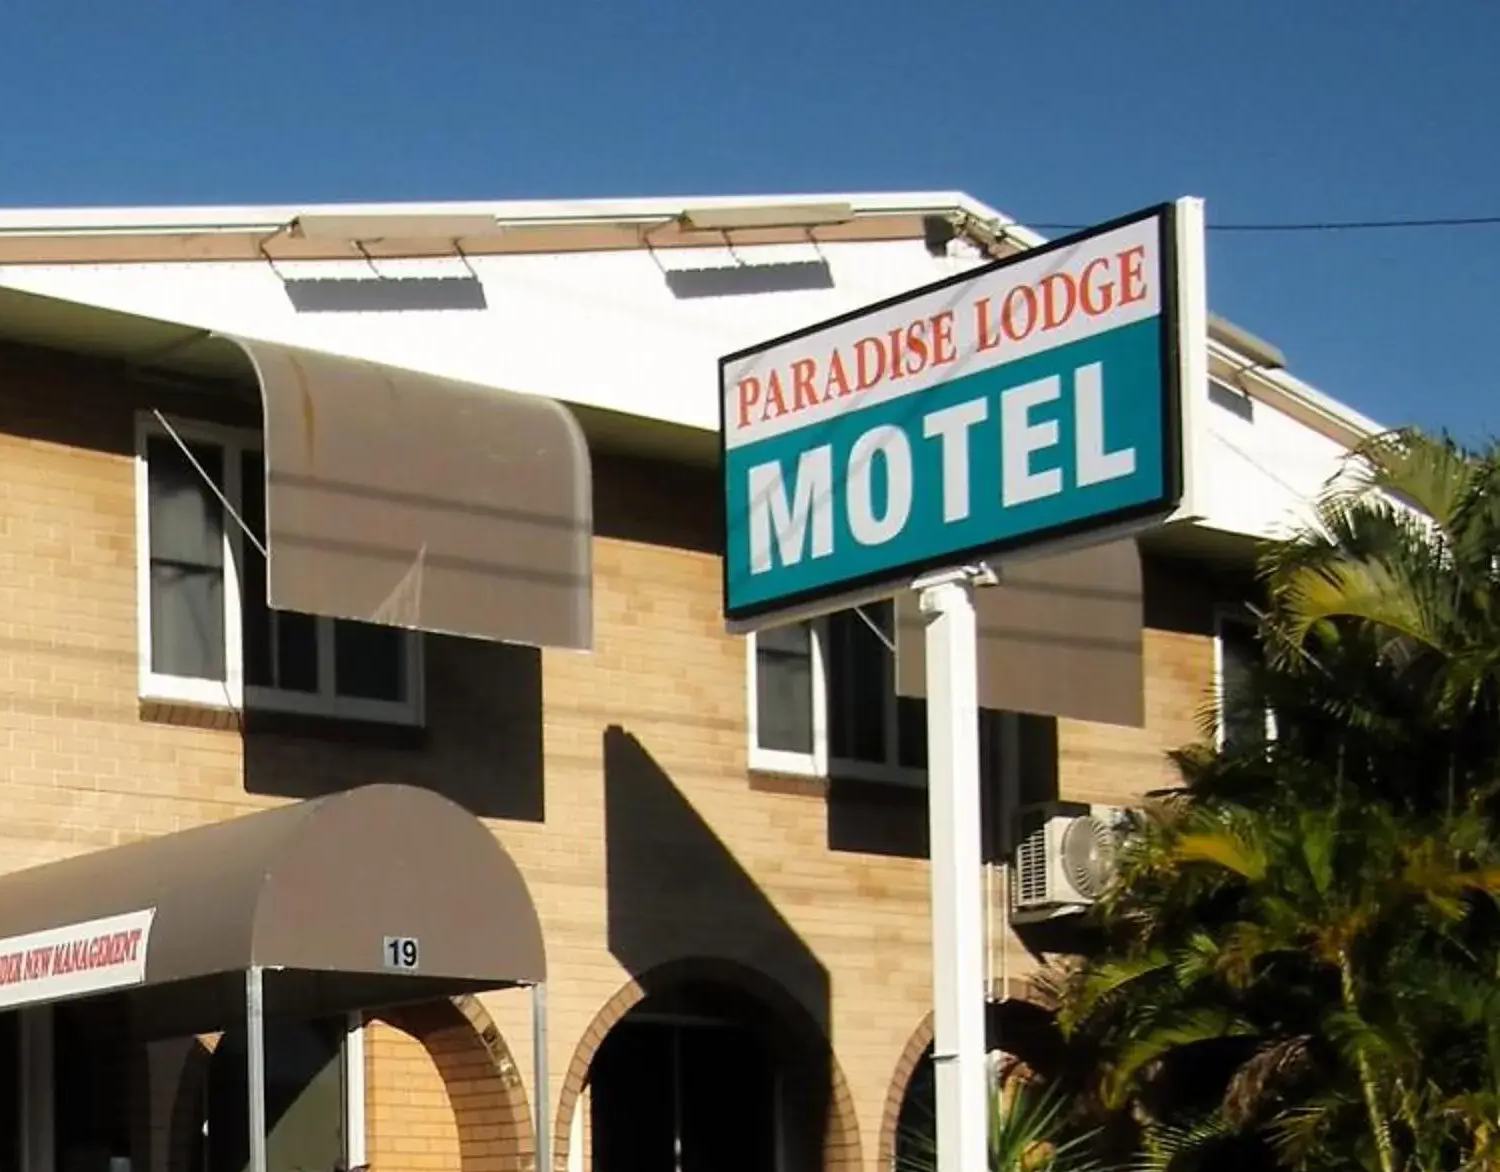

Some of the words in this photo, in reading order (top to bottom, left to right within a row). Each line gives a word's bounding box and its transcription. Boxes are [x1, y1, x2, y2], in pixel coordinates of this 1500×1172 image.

[737, 311, 957, 429] PARADISE
[974, 245, 1148, 352] LODGE
[748, 361, 1137, 575] MOTEL
[23, 946, 53, 980] NEW
[52, 928, 142, 976] MANAGEMENT
[388, 940, 417, 967] 19
